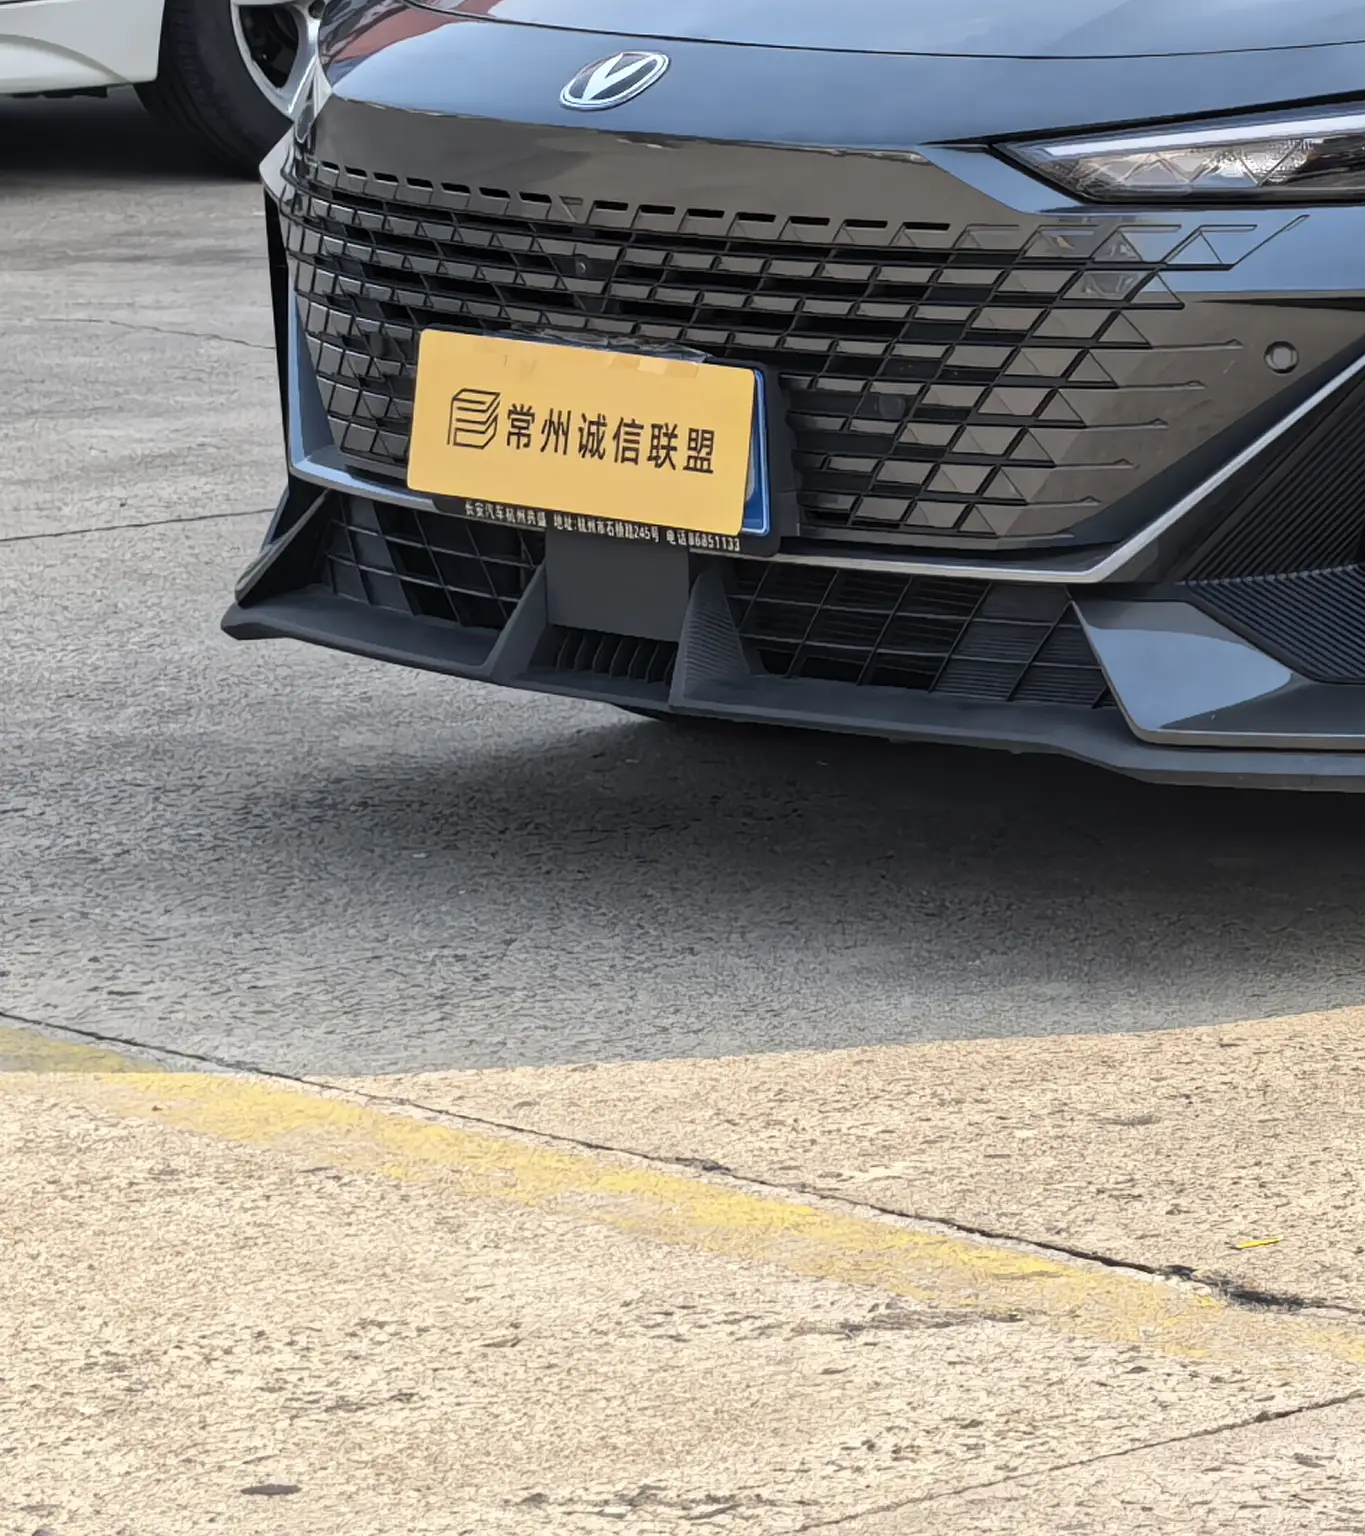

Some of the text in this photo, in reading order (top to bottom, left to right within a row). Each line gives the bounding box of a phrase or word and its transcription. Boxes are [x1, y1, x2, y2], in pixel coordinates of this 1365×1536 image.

[505, 402, 716, 475] 常州诚信联盟
